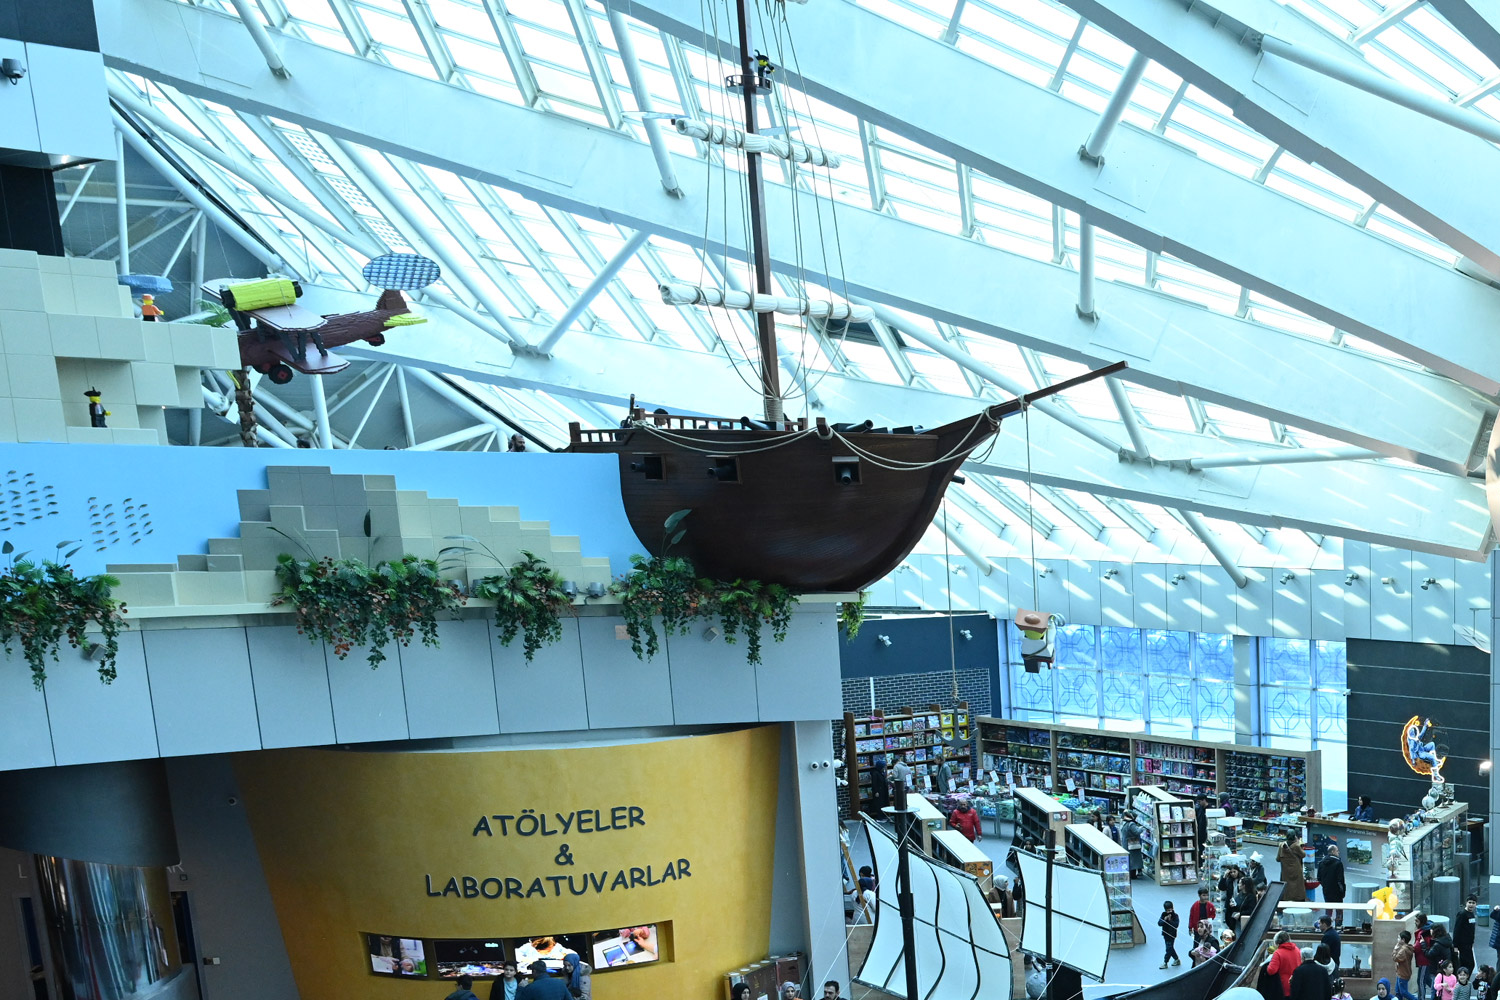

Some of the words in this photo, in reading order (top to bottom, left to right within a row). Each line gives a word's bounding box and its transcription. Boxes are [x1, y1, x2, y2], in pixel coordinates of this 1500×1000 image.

[472, 806, 646, 836] ATÖLYELER
[554, 843, 575, 866] &
[425, 858, 692, 899] LABORATUVARLAR
